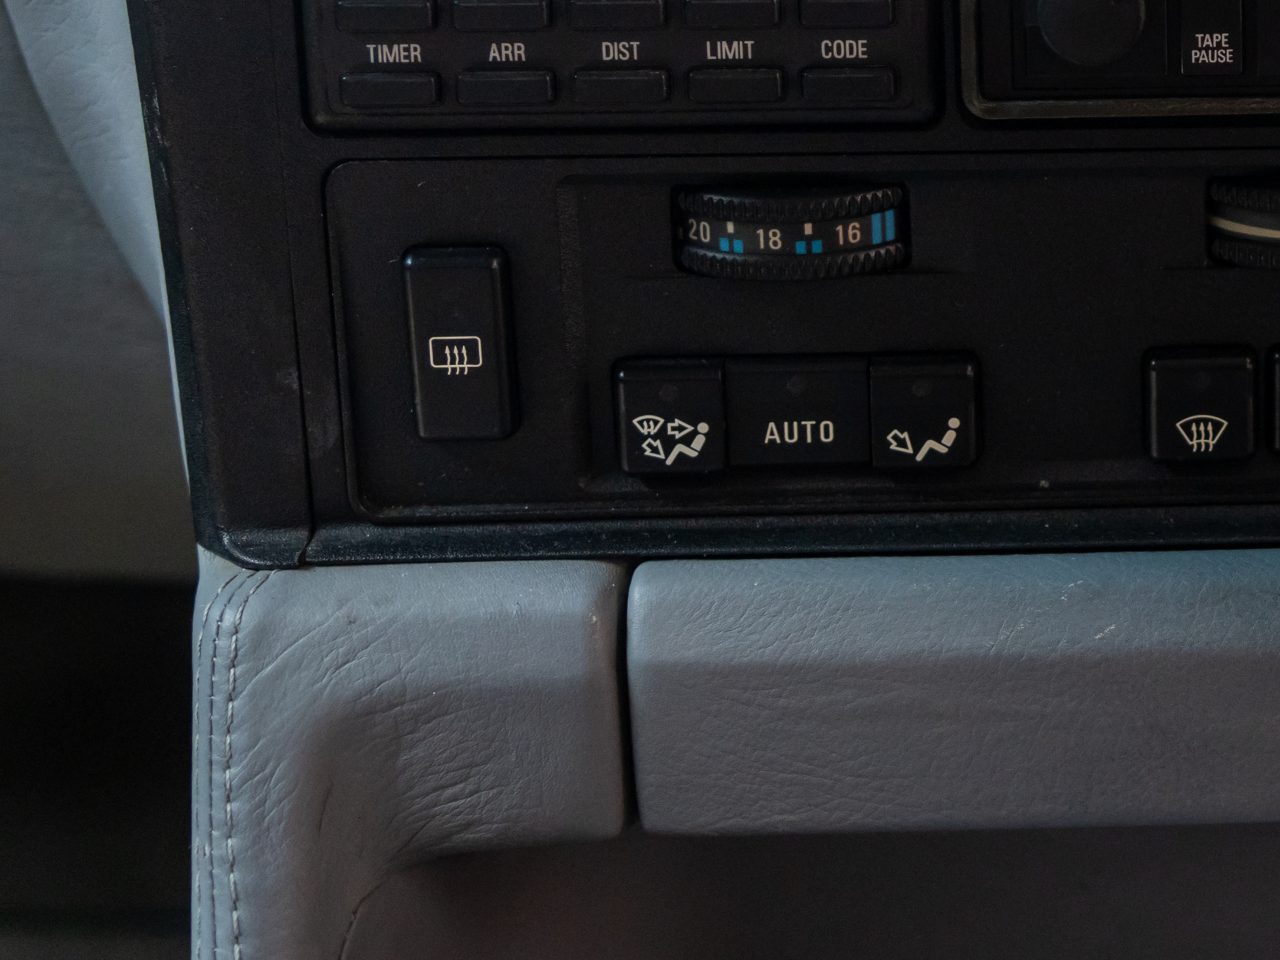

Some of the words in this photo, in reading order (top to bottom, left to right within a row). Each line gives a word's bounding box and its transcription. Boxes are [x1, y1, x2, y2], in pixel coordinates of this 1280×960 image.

[706, 41, 755, 59] LIMIT
[821, 40, 867, 58] CODE
[1195, 33, 1230, 48] TAPE
[366, 44, 421, 63] TIMER
[488, 43, 526, 62] ARR
[602, 42, 640, 61] DIST
[1191, 49, 1234, 64] PAUSE
[687, 218, 711, 243] 20
[755, 228, 783, 250] 18
[834, 221, 861, 246] 16
[764, 420, 835, 444] AUTO
